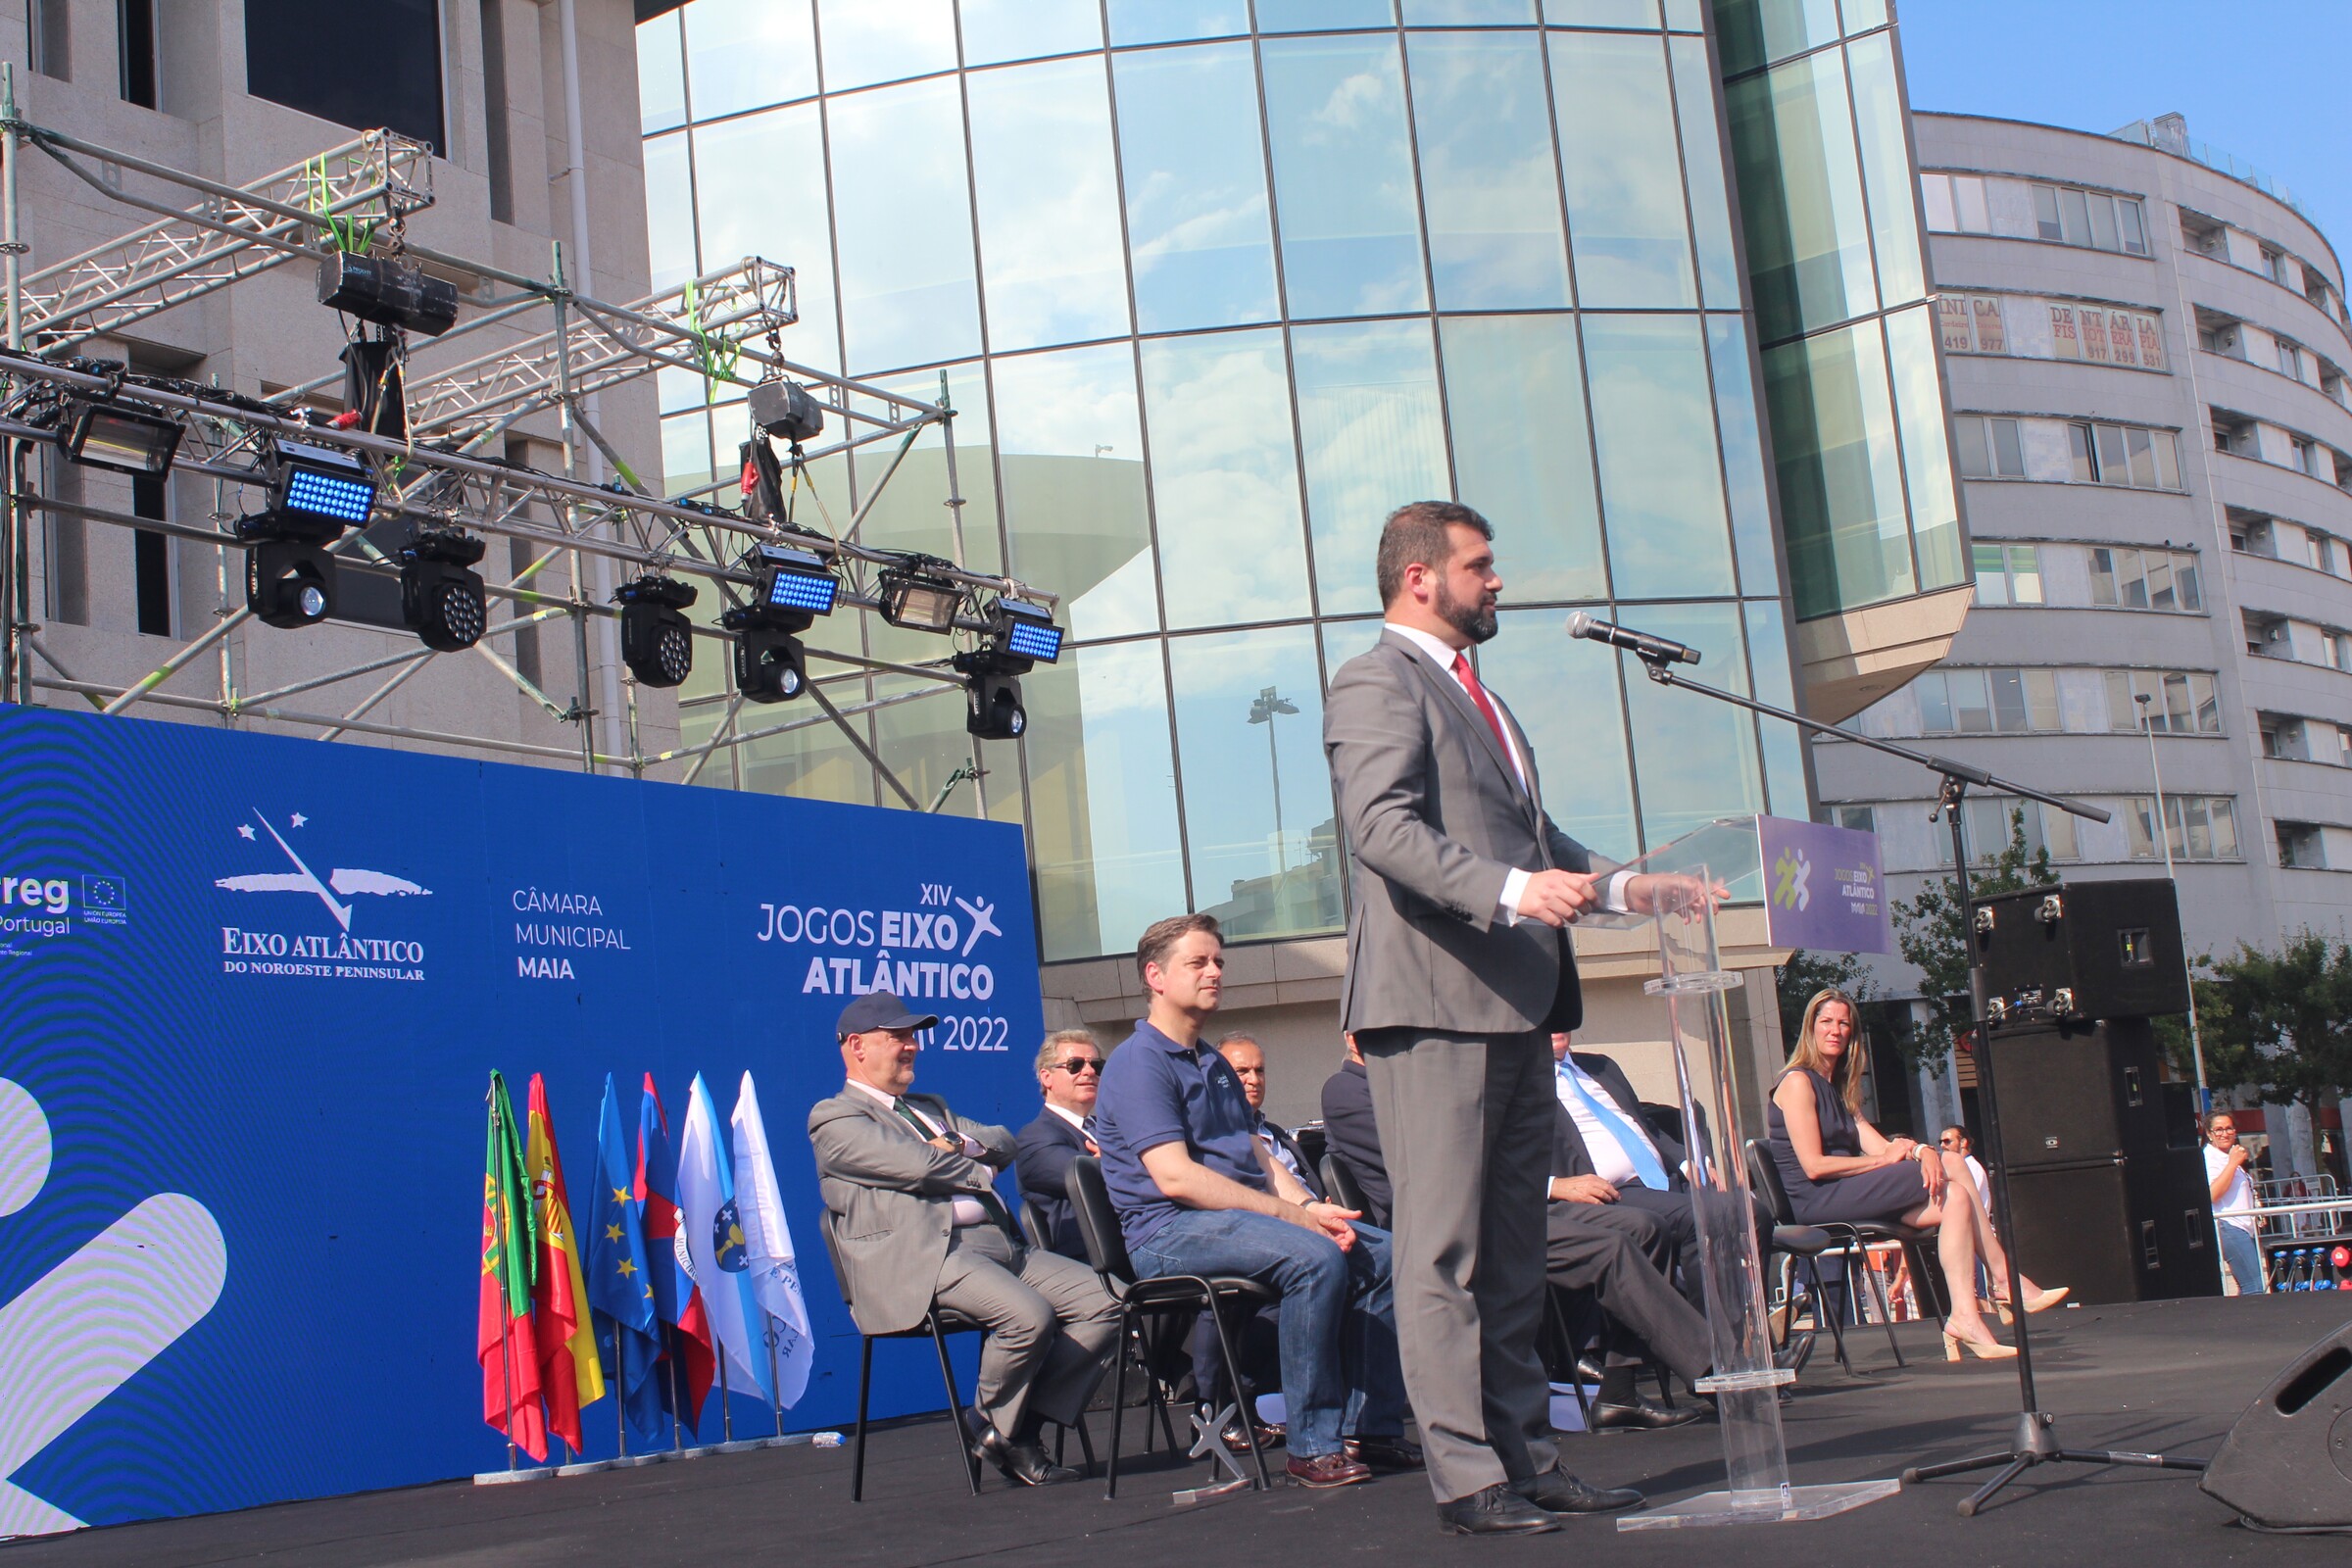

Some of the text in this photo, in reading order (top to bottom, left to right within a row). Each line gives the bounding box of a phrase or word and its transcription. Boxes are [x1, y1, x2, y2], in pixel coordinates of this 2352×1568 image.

[1944, 336, 2003, 350] 419 977
[2053, 324, 2161, 350] FISIOTERAPIA
[2087, 346, 2161, 367] 917 299 531
[1853, 870, 1868, 883] EIXO
[0, 877, 70, 913] reg
[513, 886, 604, 916] CÂMARA
[919, 883, 953, 906] XIV
[1842, 882, 1875, 900] ATLÂNTICO
[515, 923, 631, 951] MUNICIPAL
[758, 904, 958, 951] JOGOS EIXO
[222, 927, 424, 963] EIXO ATLÂNTICO
[224, 960, 425, 981] DO NOROESTE PENINSULAR
[517, 956, 575, 980] MAIA
[802, 949, 995, 1001] ATLÂNTICO
[943, 1015, 1009, 1052] 2022
